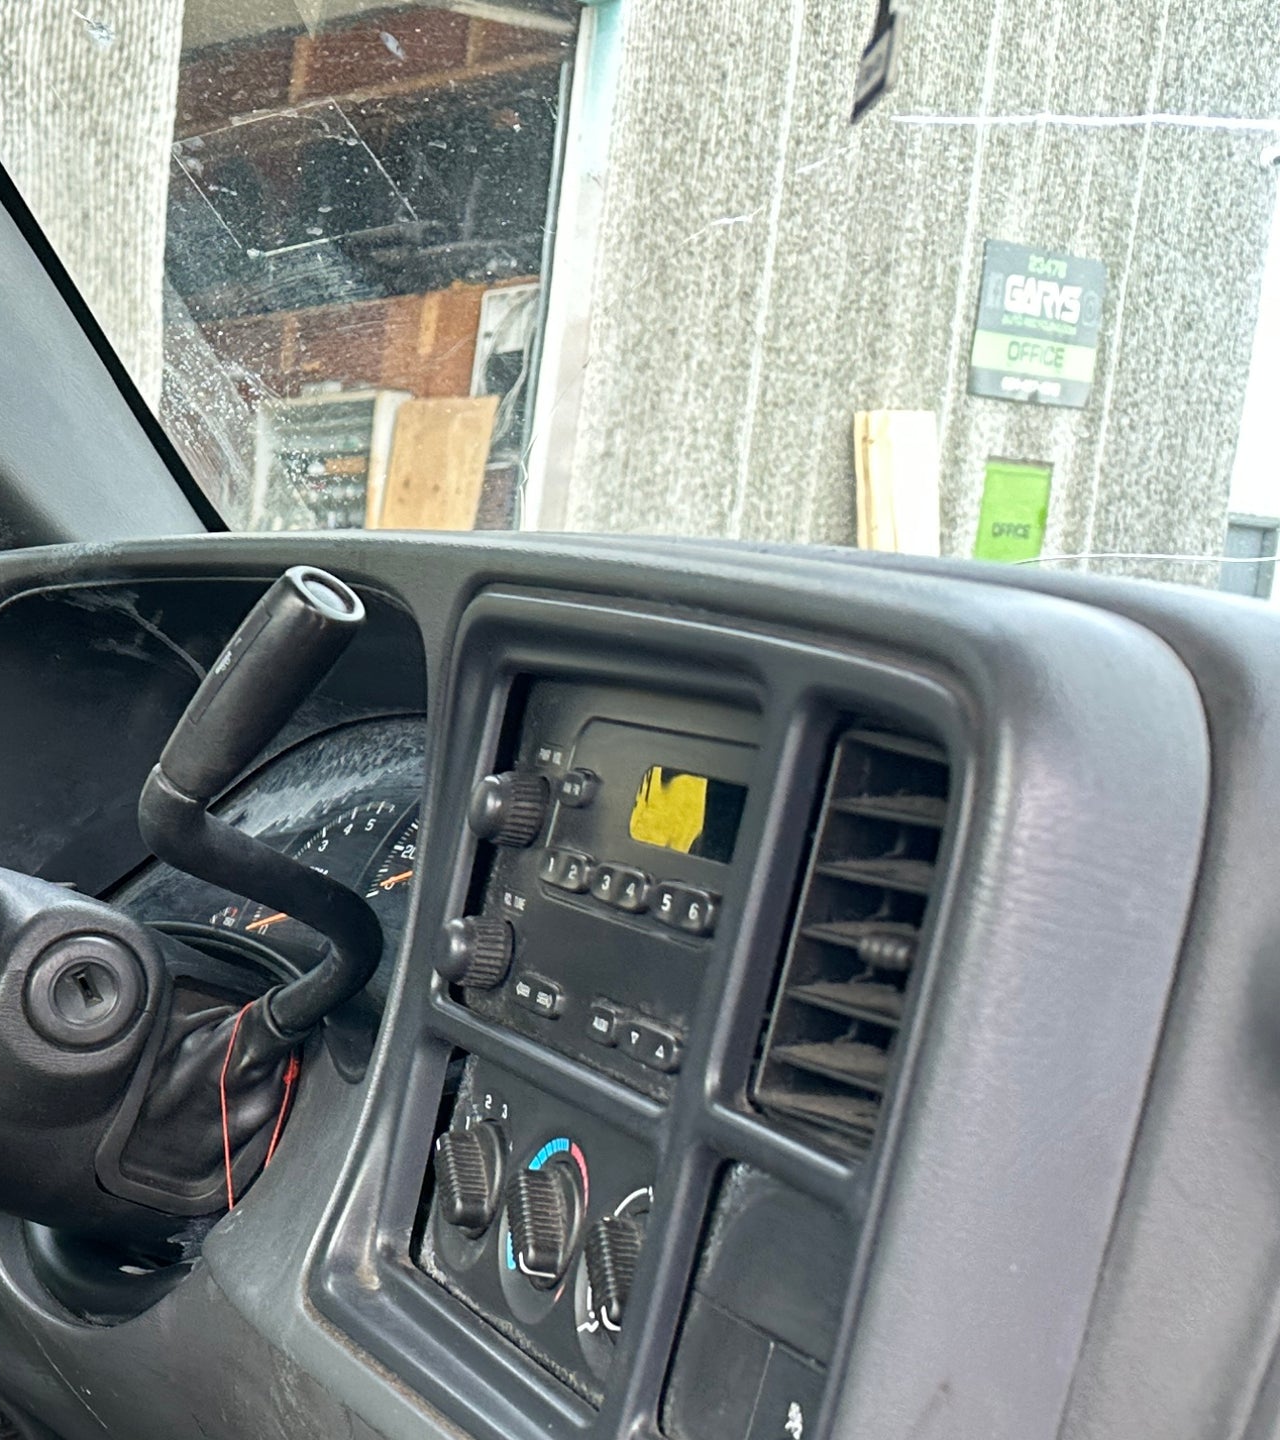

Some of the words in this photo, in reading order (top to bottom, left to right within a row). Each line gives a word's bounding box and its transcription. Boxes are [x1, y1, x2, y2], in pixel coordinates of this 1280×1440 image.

[1007, 340, 1065, 368] OFFICE
[317, 839, 329, 852] 3
[343, 823, 354, 836] 4
[364, 818, 377, 831] 5
[548, 857, 555, 873] 1
[567, 864, 578, 880] 2
[601, 874, 611, 891] 3
[625, 882, 636, 898] 4
[660, 893, 673, 912] 5
[688, 902, 700, 920] 6
[484, 1094, 493, 1109] 2
[501, 1103, 508, 1119] 3
